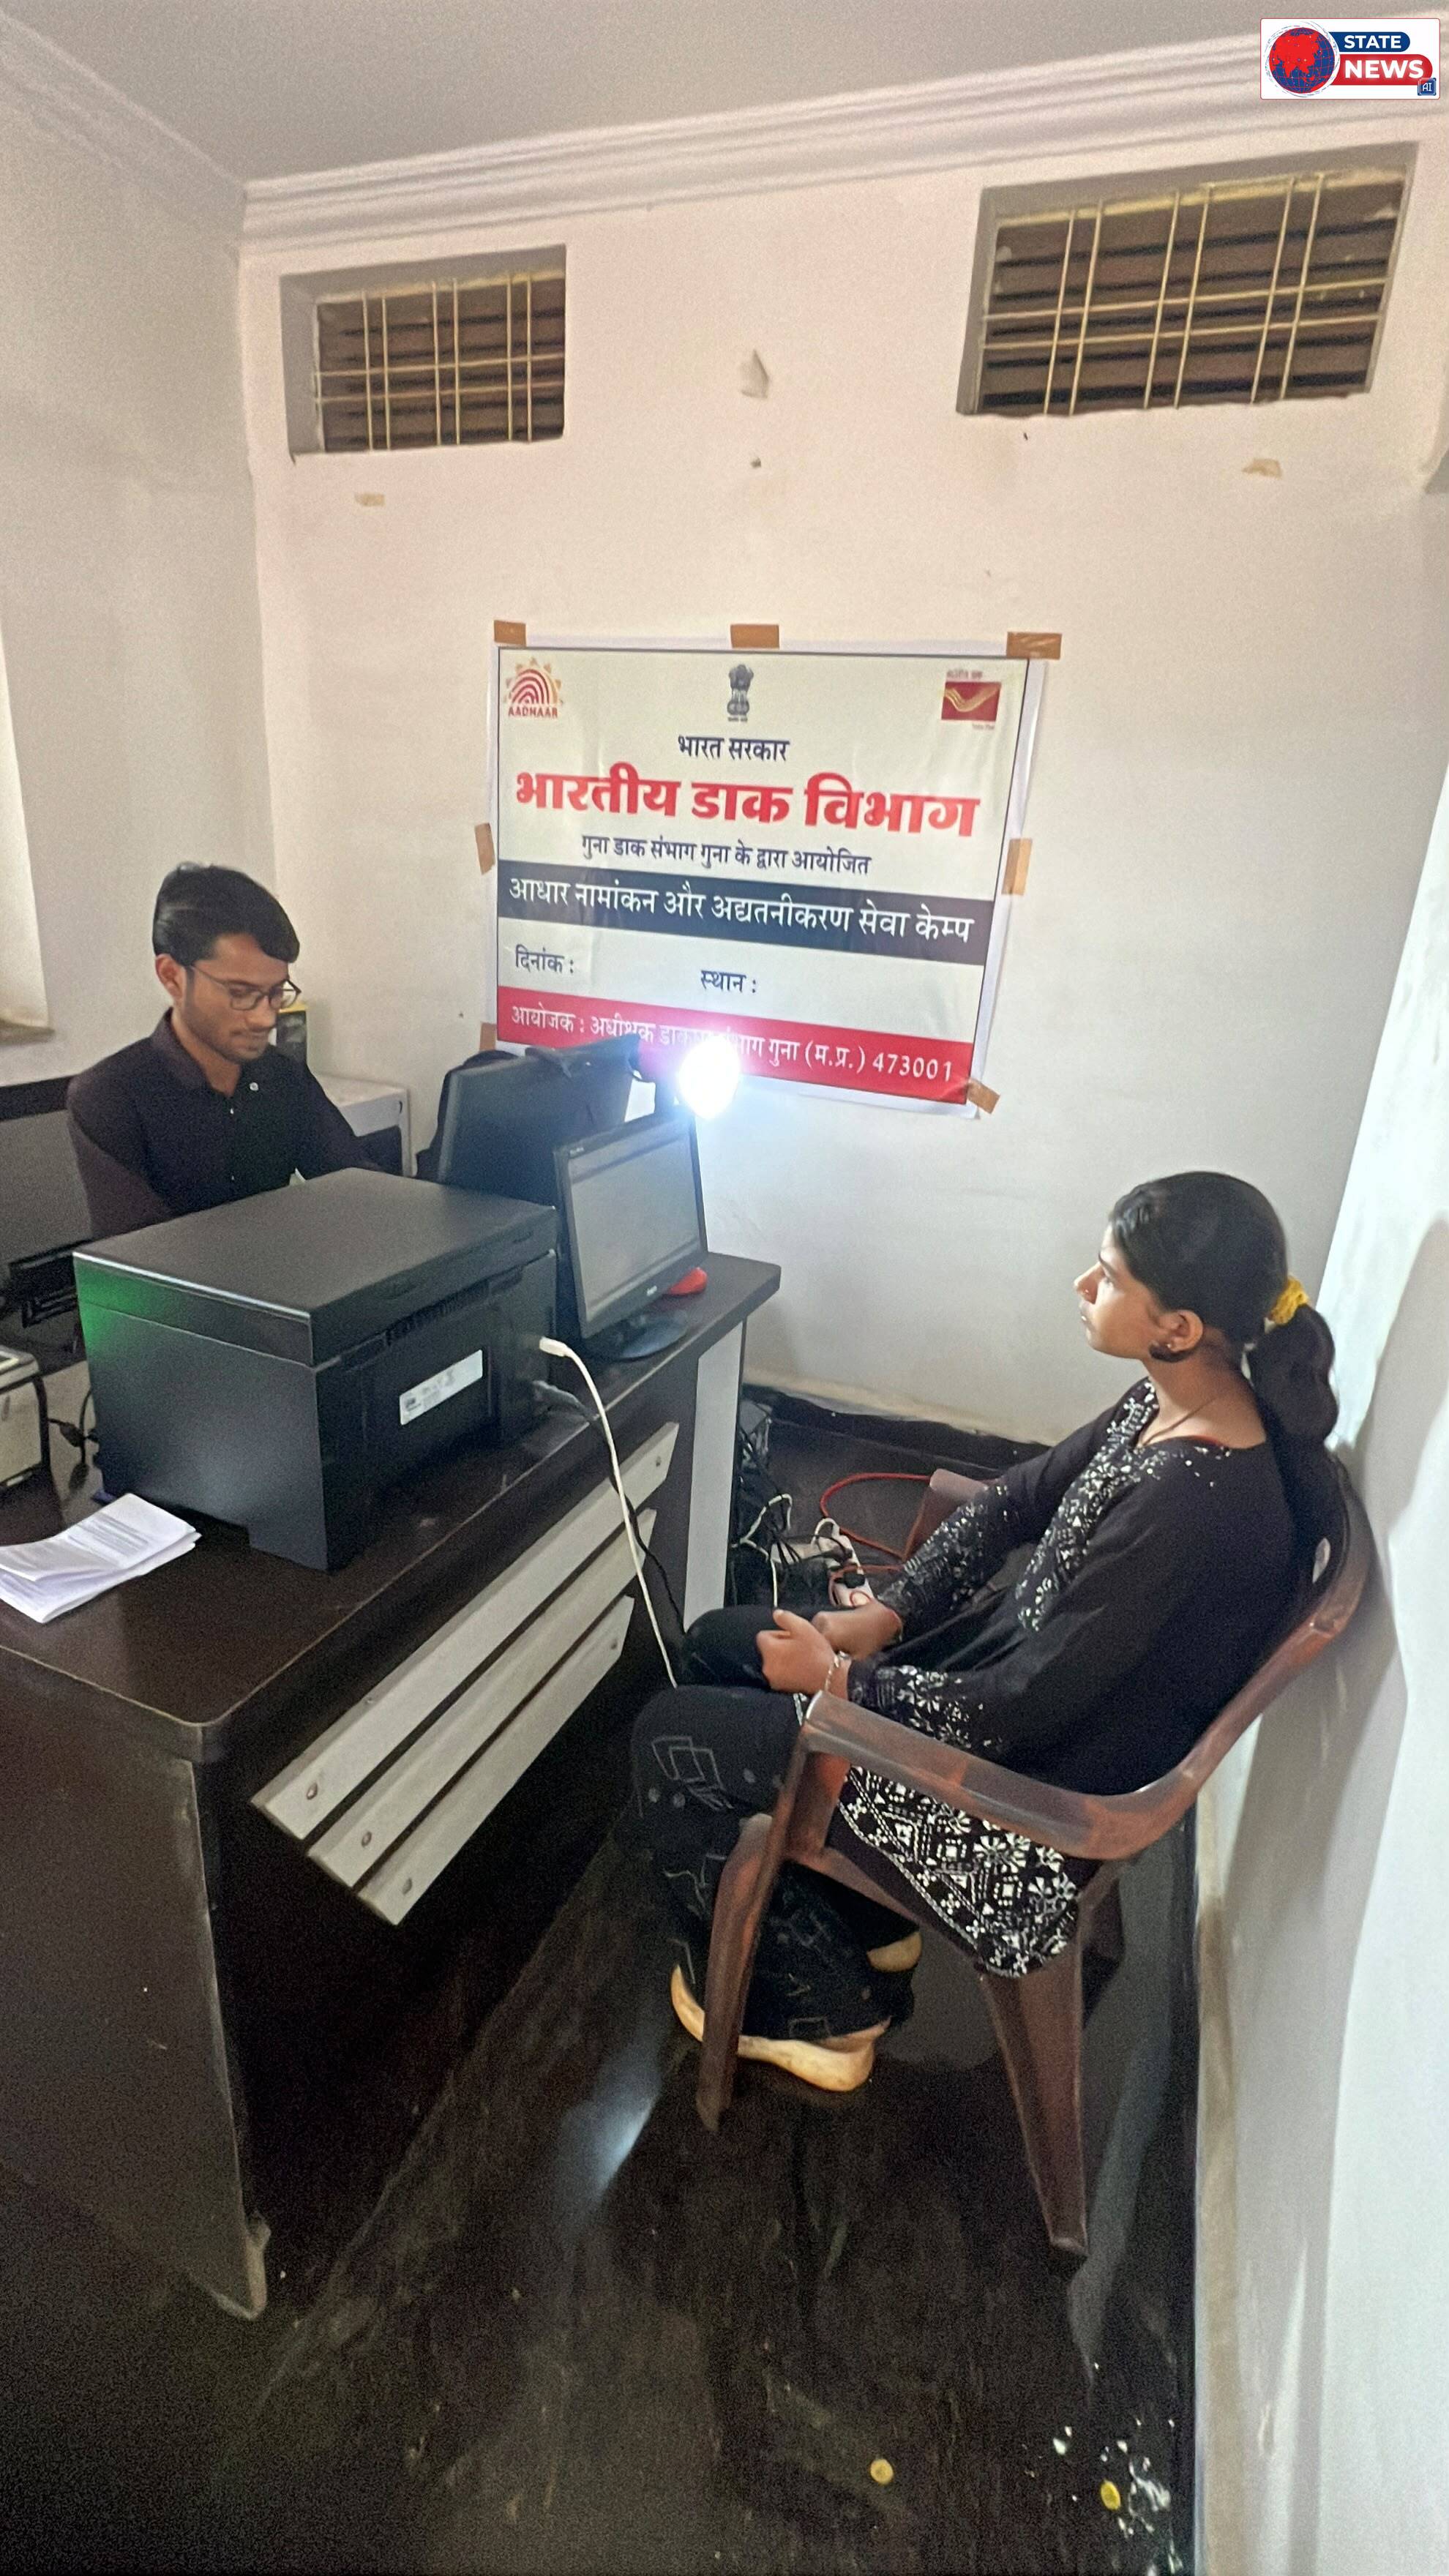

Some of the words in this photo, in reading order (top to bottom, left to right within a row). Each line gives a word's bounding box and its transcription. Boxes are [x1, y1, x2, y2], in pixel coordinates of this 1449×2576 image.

[508, 705, 558, 718] AADHAAR
[678, 735, 724, 760] भारत
[729, 738, 790, 761] सरकार
[516, 760, 681, 817] भारतीय
[691, 782, 793, 823] डाक
[804, 771, 981, 837] विभाग
[582, 835, 610, 859] गुना
[613, 837, 648, 856] डाक
[651, 835, 696, 861] संभाग
[700, 844, 732, 869] गुना
[735, 839, 753, 866] के
[756, 847, 788, 869] द्वारा
[791, 846, 872, 876] आयोजित
[509, 877, 571, 906] आधार
[574, 880, 659, 914] नामांकन
[663, 880, 707, 919] और
[711, 892, 855, 934] अद्यतनीकरण
[858, 899, 910, 937] सेवा
[915, 903, 976, 943] केम्प
[514, 944, 565, 973] दिनांक
[700, 969, 747, 993] स्थान
[512, 1001, 576, 1033] आयोजक
[768, 1036, 801, 1068] गुना
[804, 1039, 866, 1074] (म.प्र.)
[872, 1052, 952, 1082] 473001
